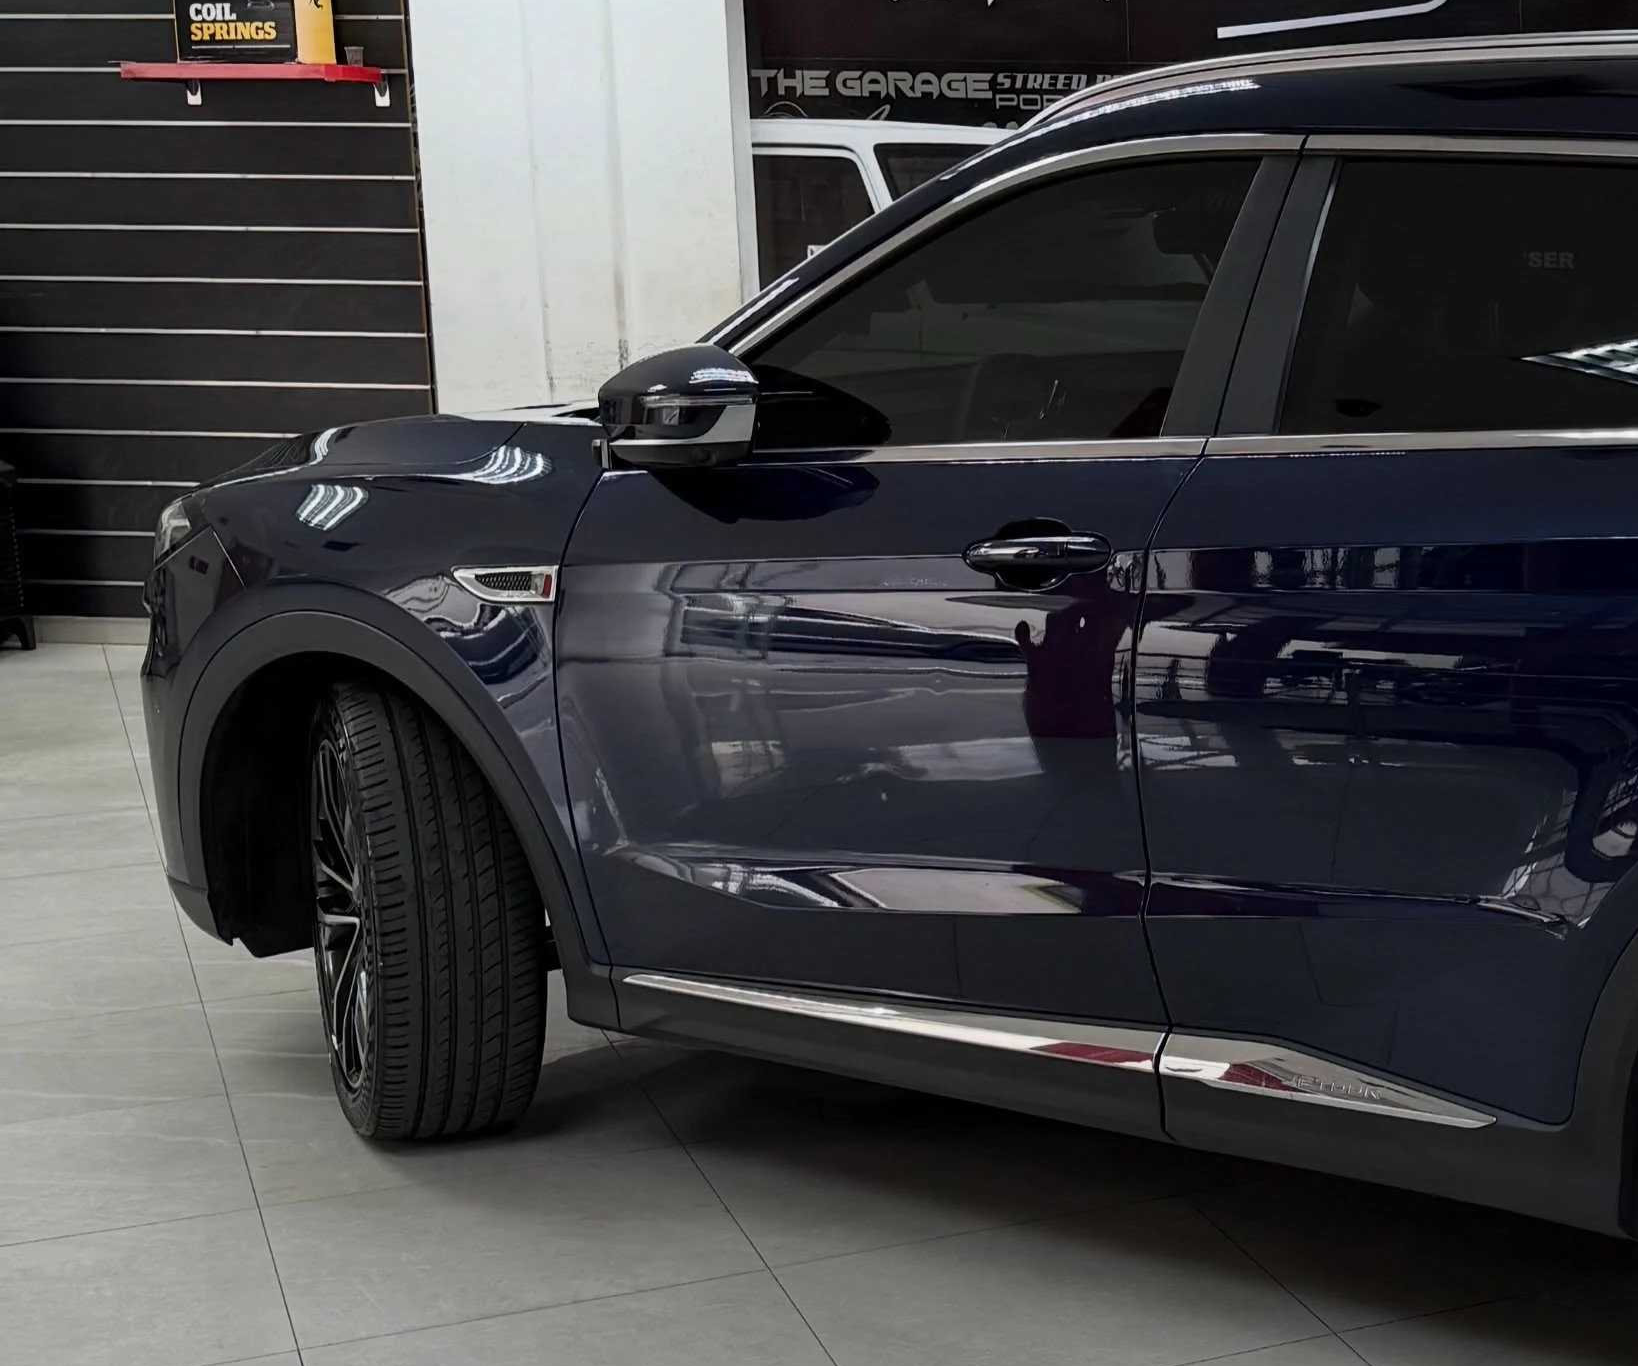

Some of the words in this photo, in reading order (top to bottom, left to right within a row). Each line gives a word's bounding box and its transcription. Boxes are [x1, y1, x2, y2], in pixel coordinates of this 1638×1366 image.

[189, 3, 237, 21] COIL
[190, 21, 277, 41] SPRINGS
[751, 69, 830, 98] THE
[835, 71, 994, 100] GARAGE
[996, 73, 1088, 90] STREED
